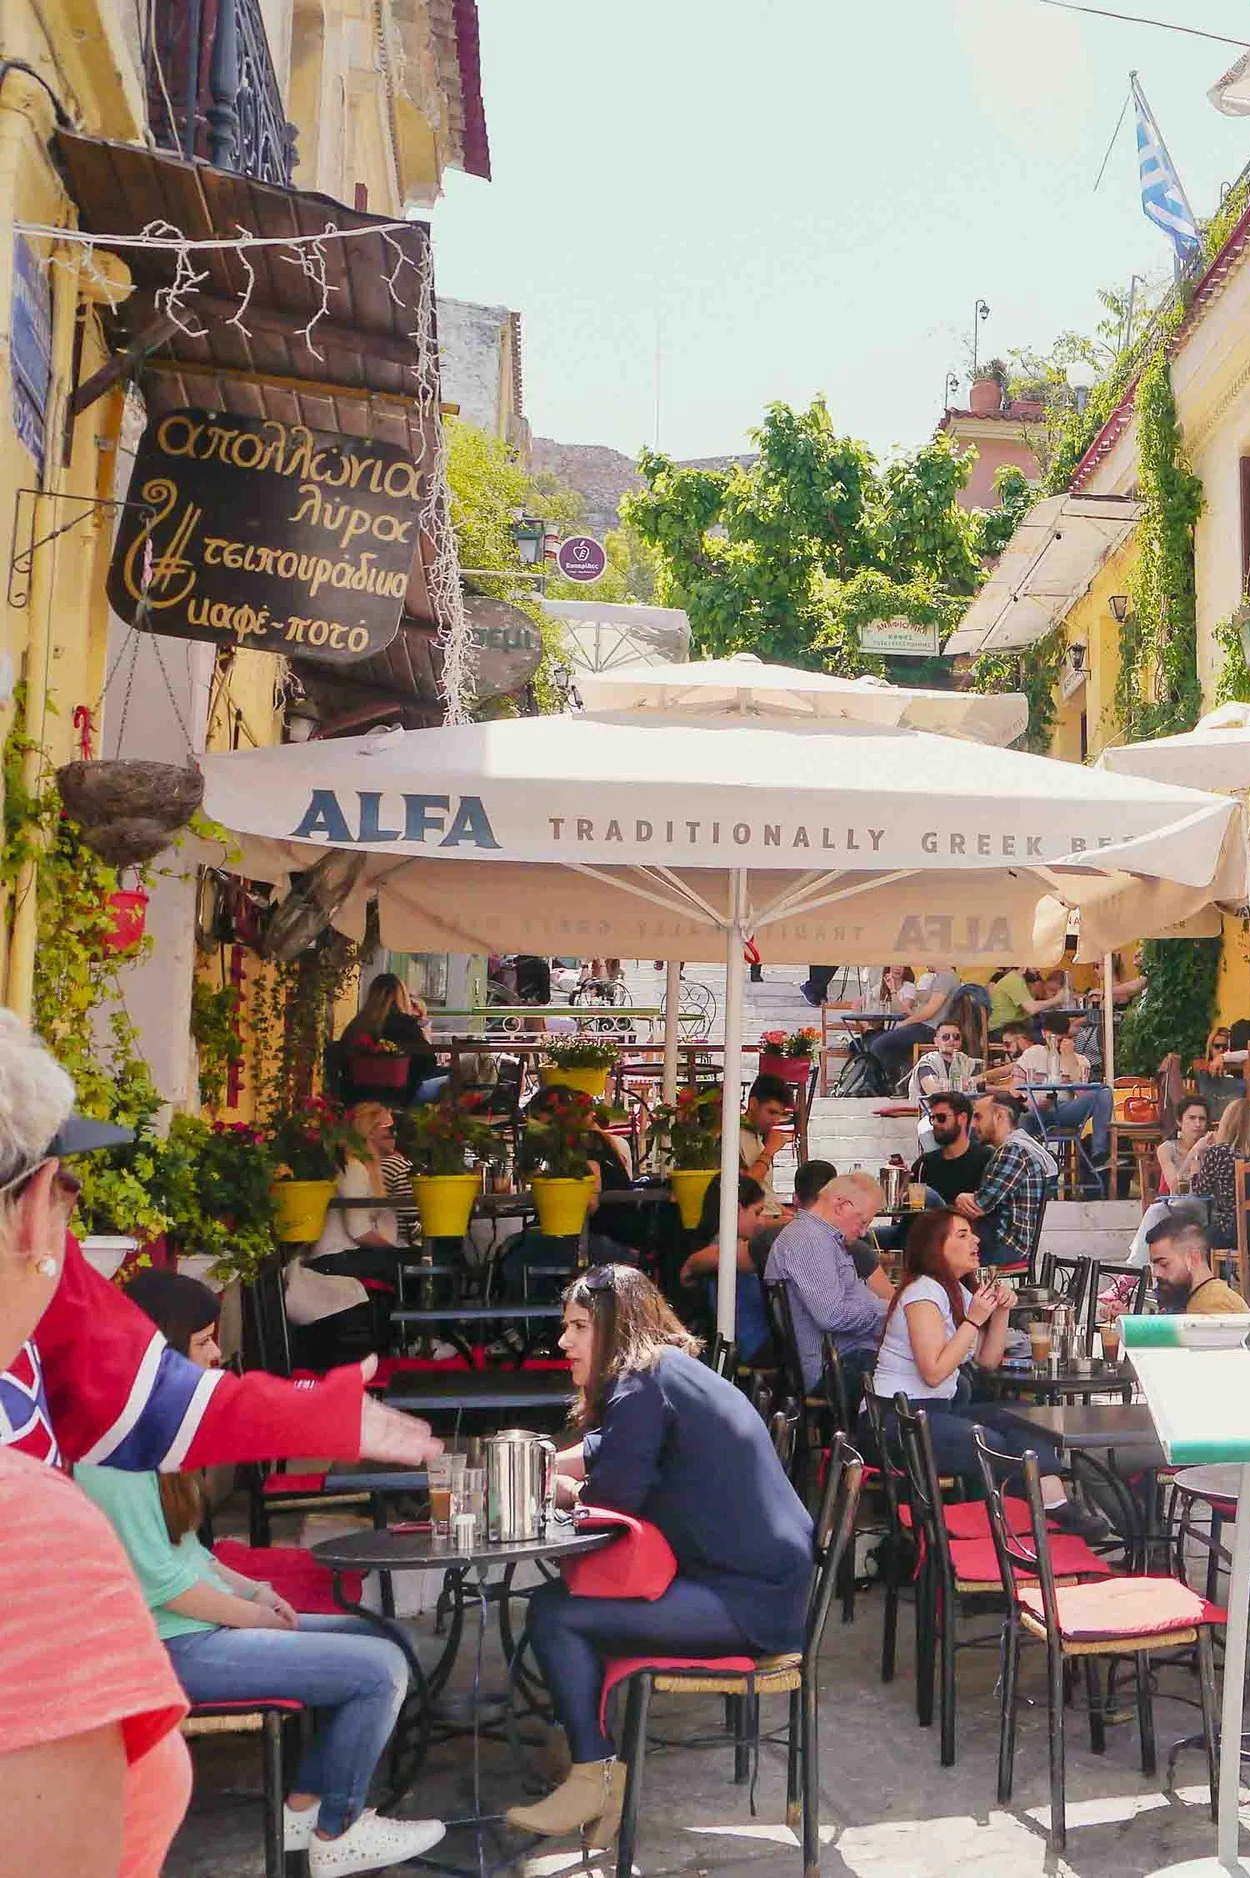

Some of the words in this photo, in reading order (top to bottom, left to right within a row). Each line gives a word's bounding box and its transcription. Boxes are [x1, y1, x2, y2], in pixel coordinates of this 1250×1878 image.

[288, 484, 413, 548] λύρα
[287, 788, 503, 849] ALFA
[548, 816, 887, 852] TRADITIONALLY
[920, 831, 1044, 857] GREEK
